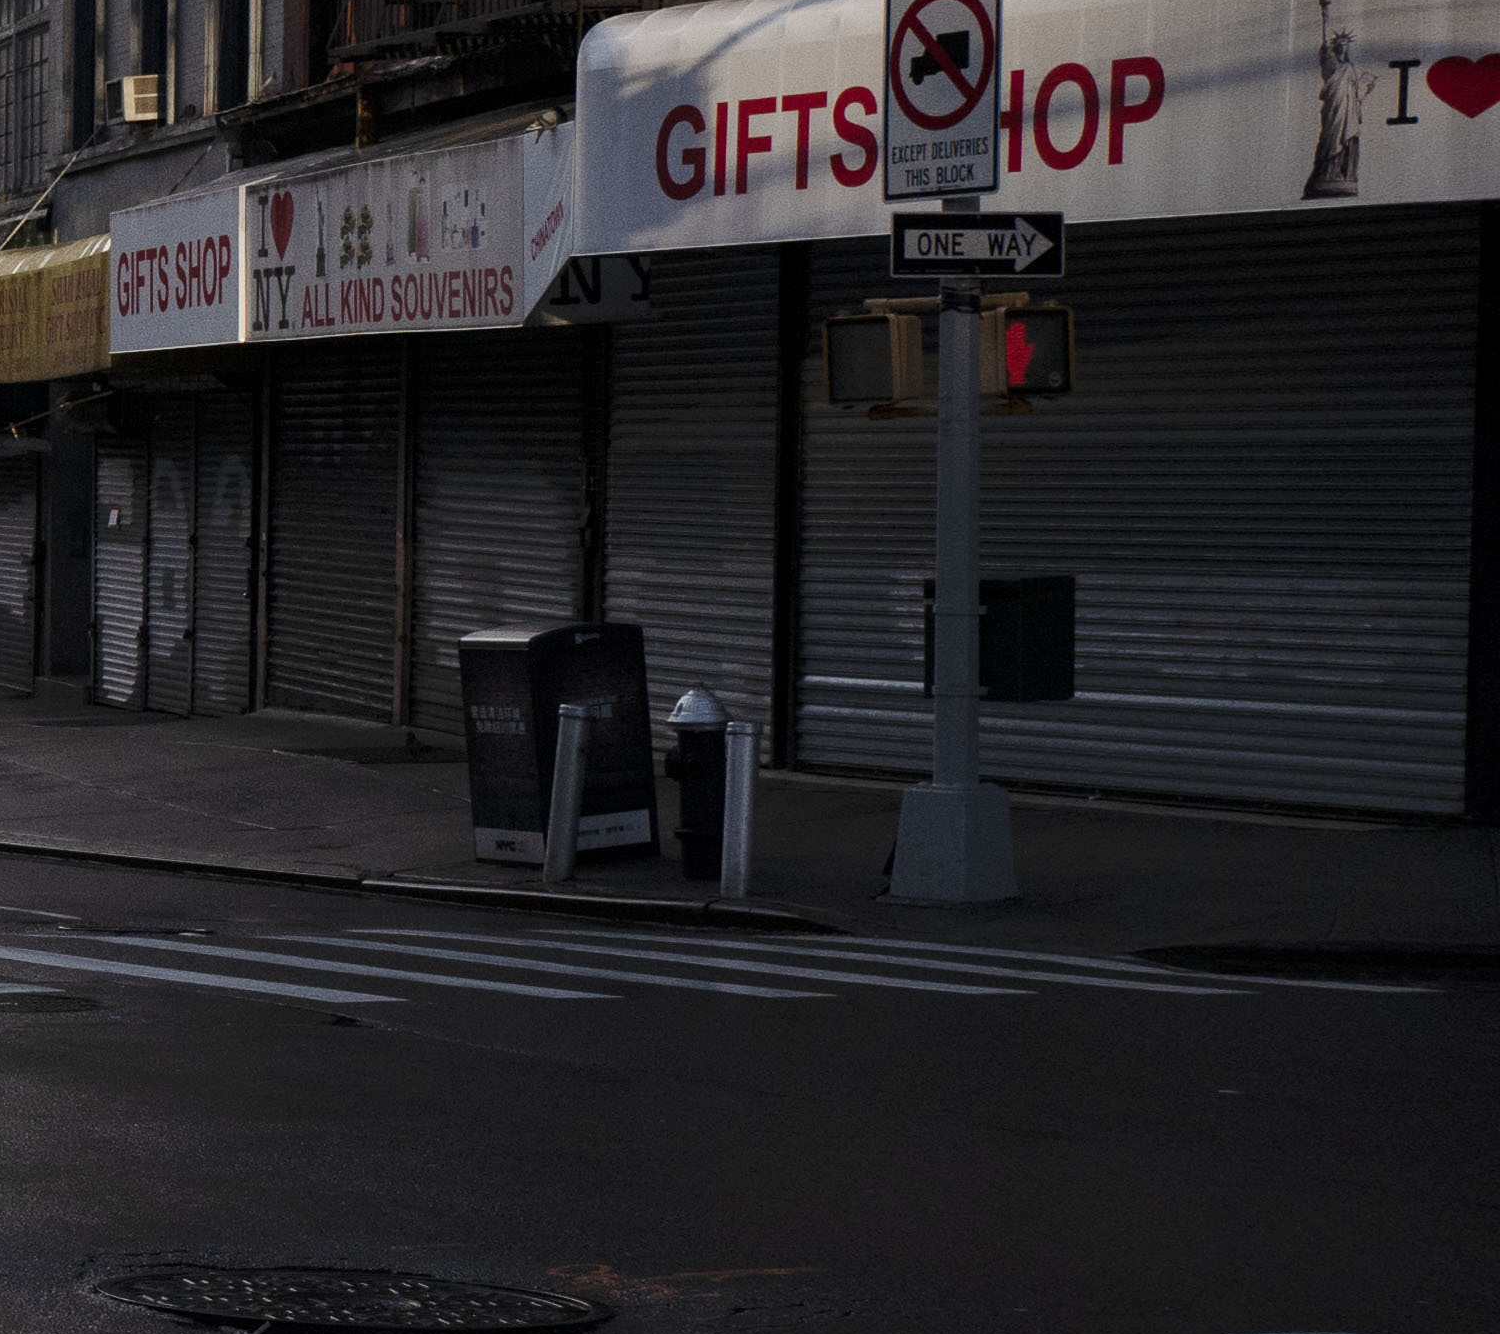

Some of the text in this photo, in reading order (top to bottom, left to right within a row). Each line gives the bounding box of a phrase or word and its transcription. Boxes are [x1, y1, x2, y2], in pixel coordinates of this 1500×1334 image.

[1387, 60, 1421, 125] I
[655, 56, 1165, 201] GIFTS HOP
[891, 137, 989, 164] EXCEPT DELIVERIES
[905, 164, 975, 187] THIS BLOCK
[258, 196, 269, 258] I
[917, 232, 1038, 256] ONE WAY
[116, 243, 169, 317] GIFTS
[175, 234, 231, 310] SHOP
[301, 265, 515, 329] ALL KIND SOUVENIRS
